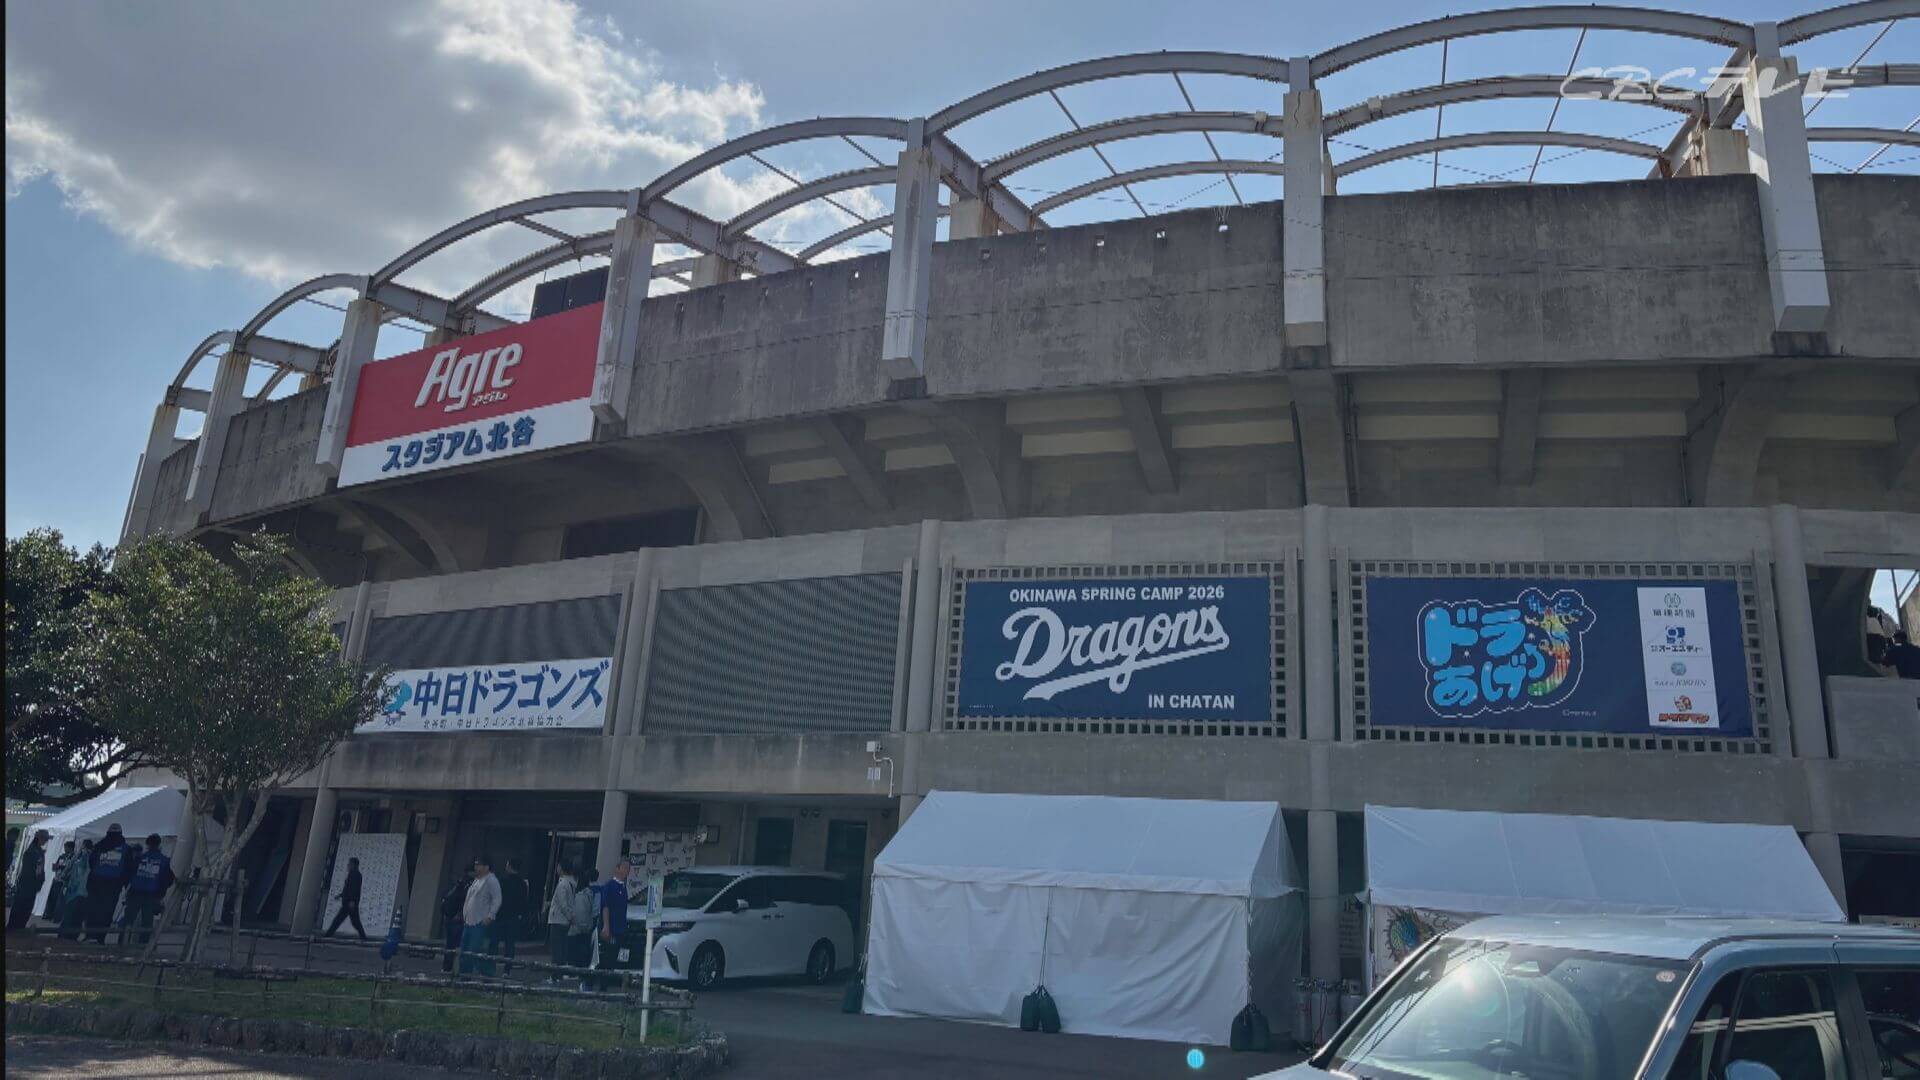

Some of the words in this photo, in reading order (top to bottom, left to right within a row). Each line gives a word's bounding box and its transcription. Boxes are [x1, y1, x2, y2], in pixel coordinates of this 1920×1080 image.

[414, 342, 524, 413] Agre
[382, 415, 536, 473] スタジアム北谷
[1010, 587, 1077, 602] OKINAWA
[1081, 586, 1136, 601] SPRING
[1141, 586, 1184, 600] CAMP
[1188, 585, 1225, 600] 2026
[995, 605, 1230, 696] Dragons
[1425, 607, 1526, 666] ドラ
[413, 658, 610, 718] 中日ドラゴンズ
[1148, 694, 1164, 709] IN
[1169, 694, 1235, 709] CHATAN
